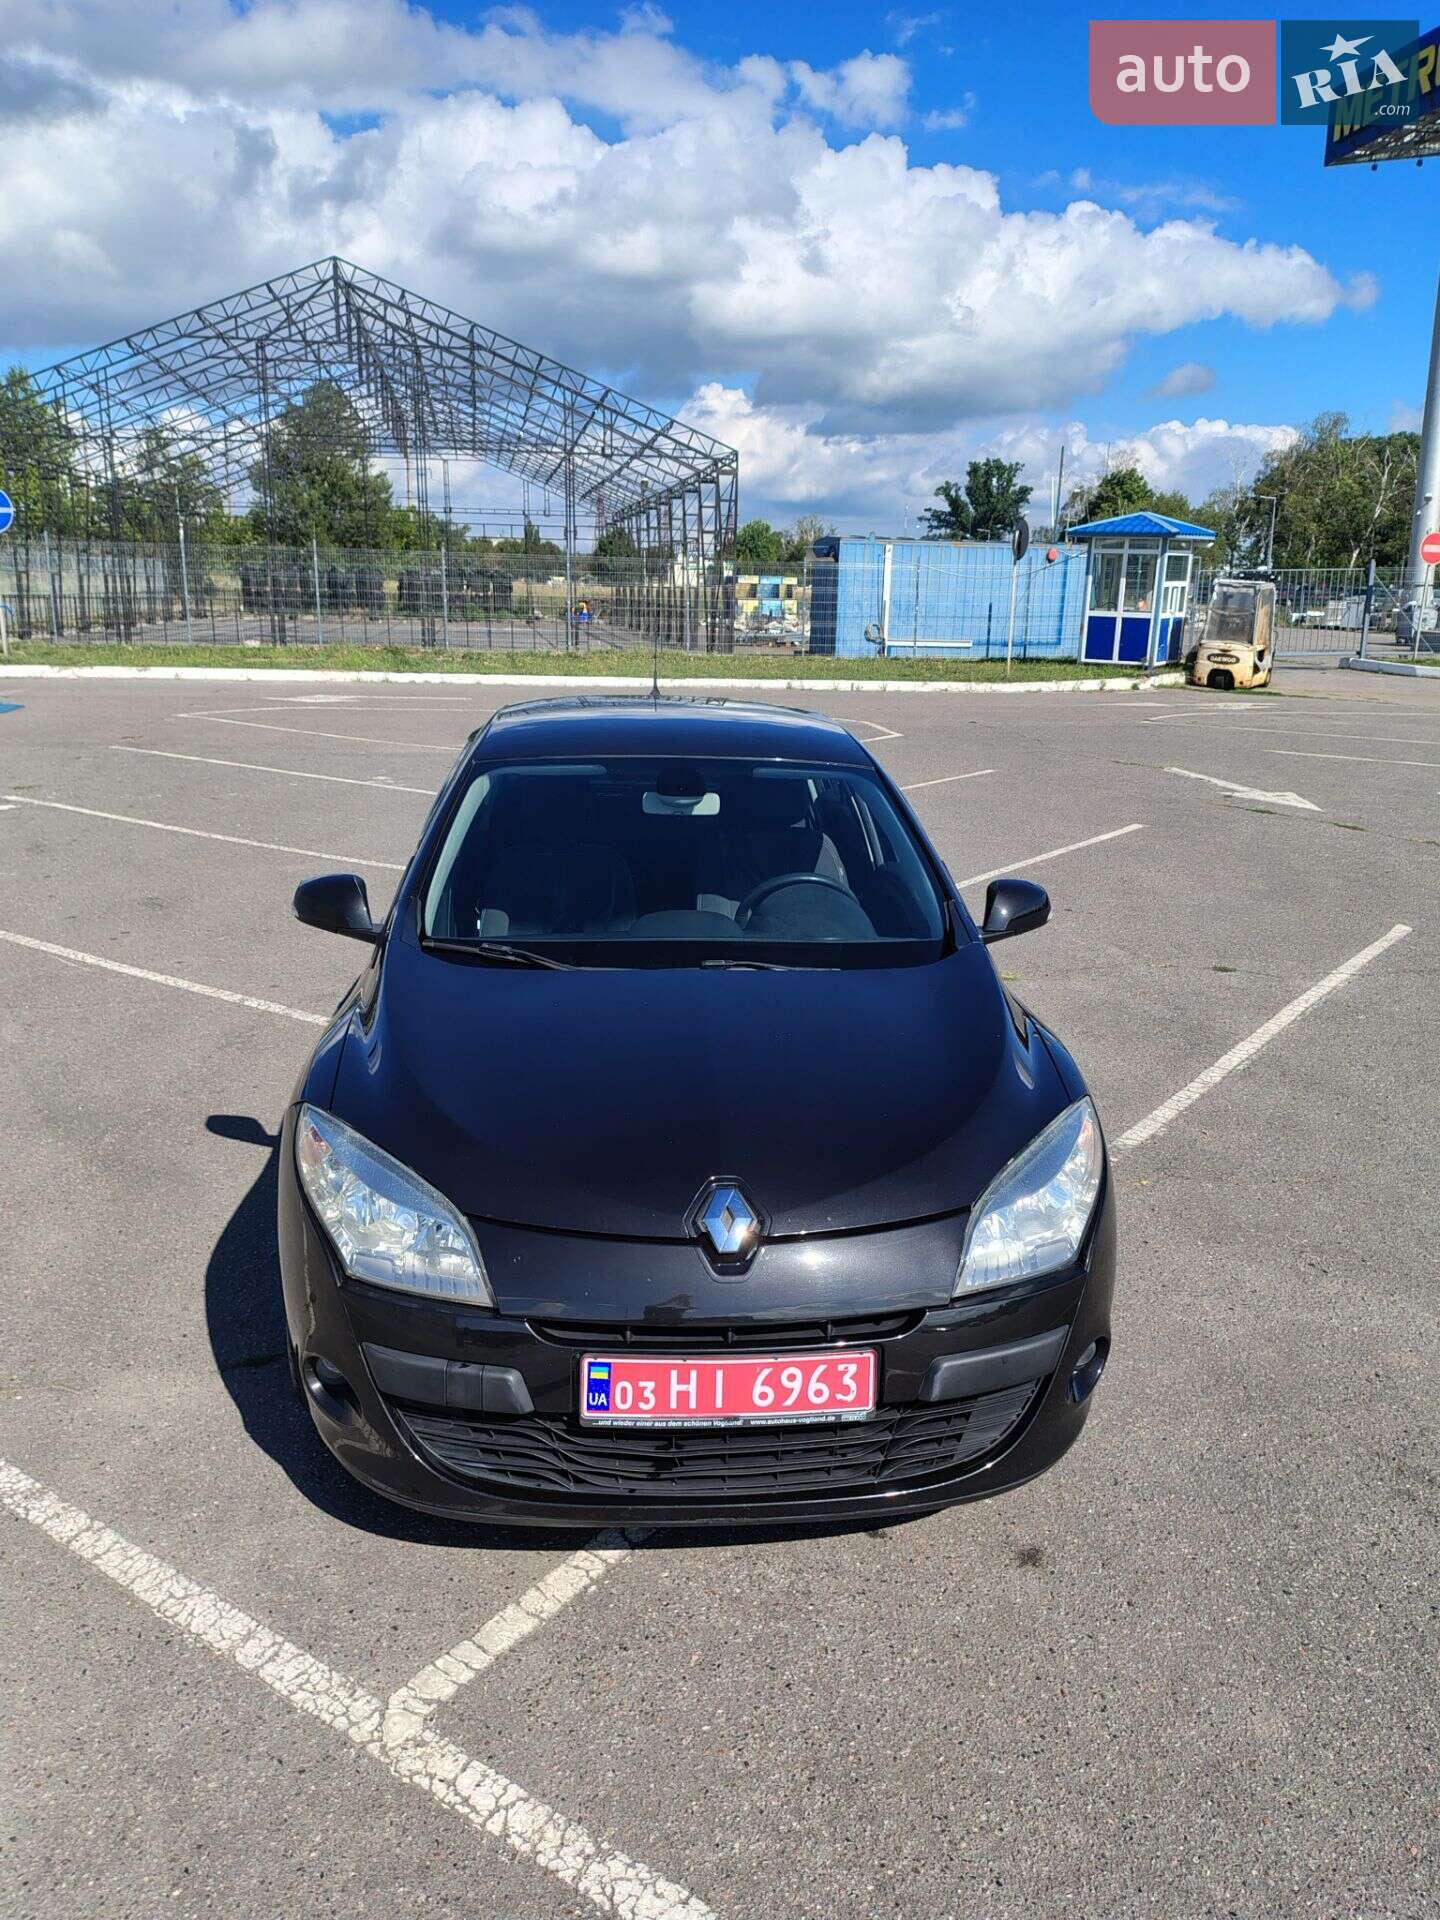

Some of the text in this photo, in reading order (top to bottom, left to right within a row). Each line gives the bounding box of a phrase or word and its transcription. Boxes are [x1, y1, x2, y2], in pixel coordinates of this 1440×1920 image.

[1210, 655, 1236, 663] DAEWOO
[614, 1363, 858, 1411] 03 HI 6963
[588, 1392, 608, 1407] UA
